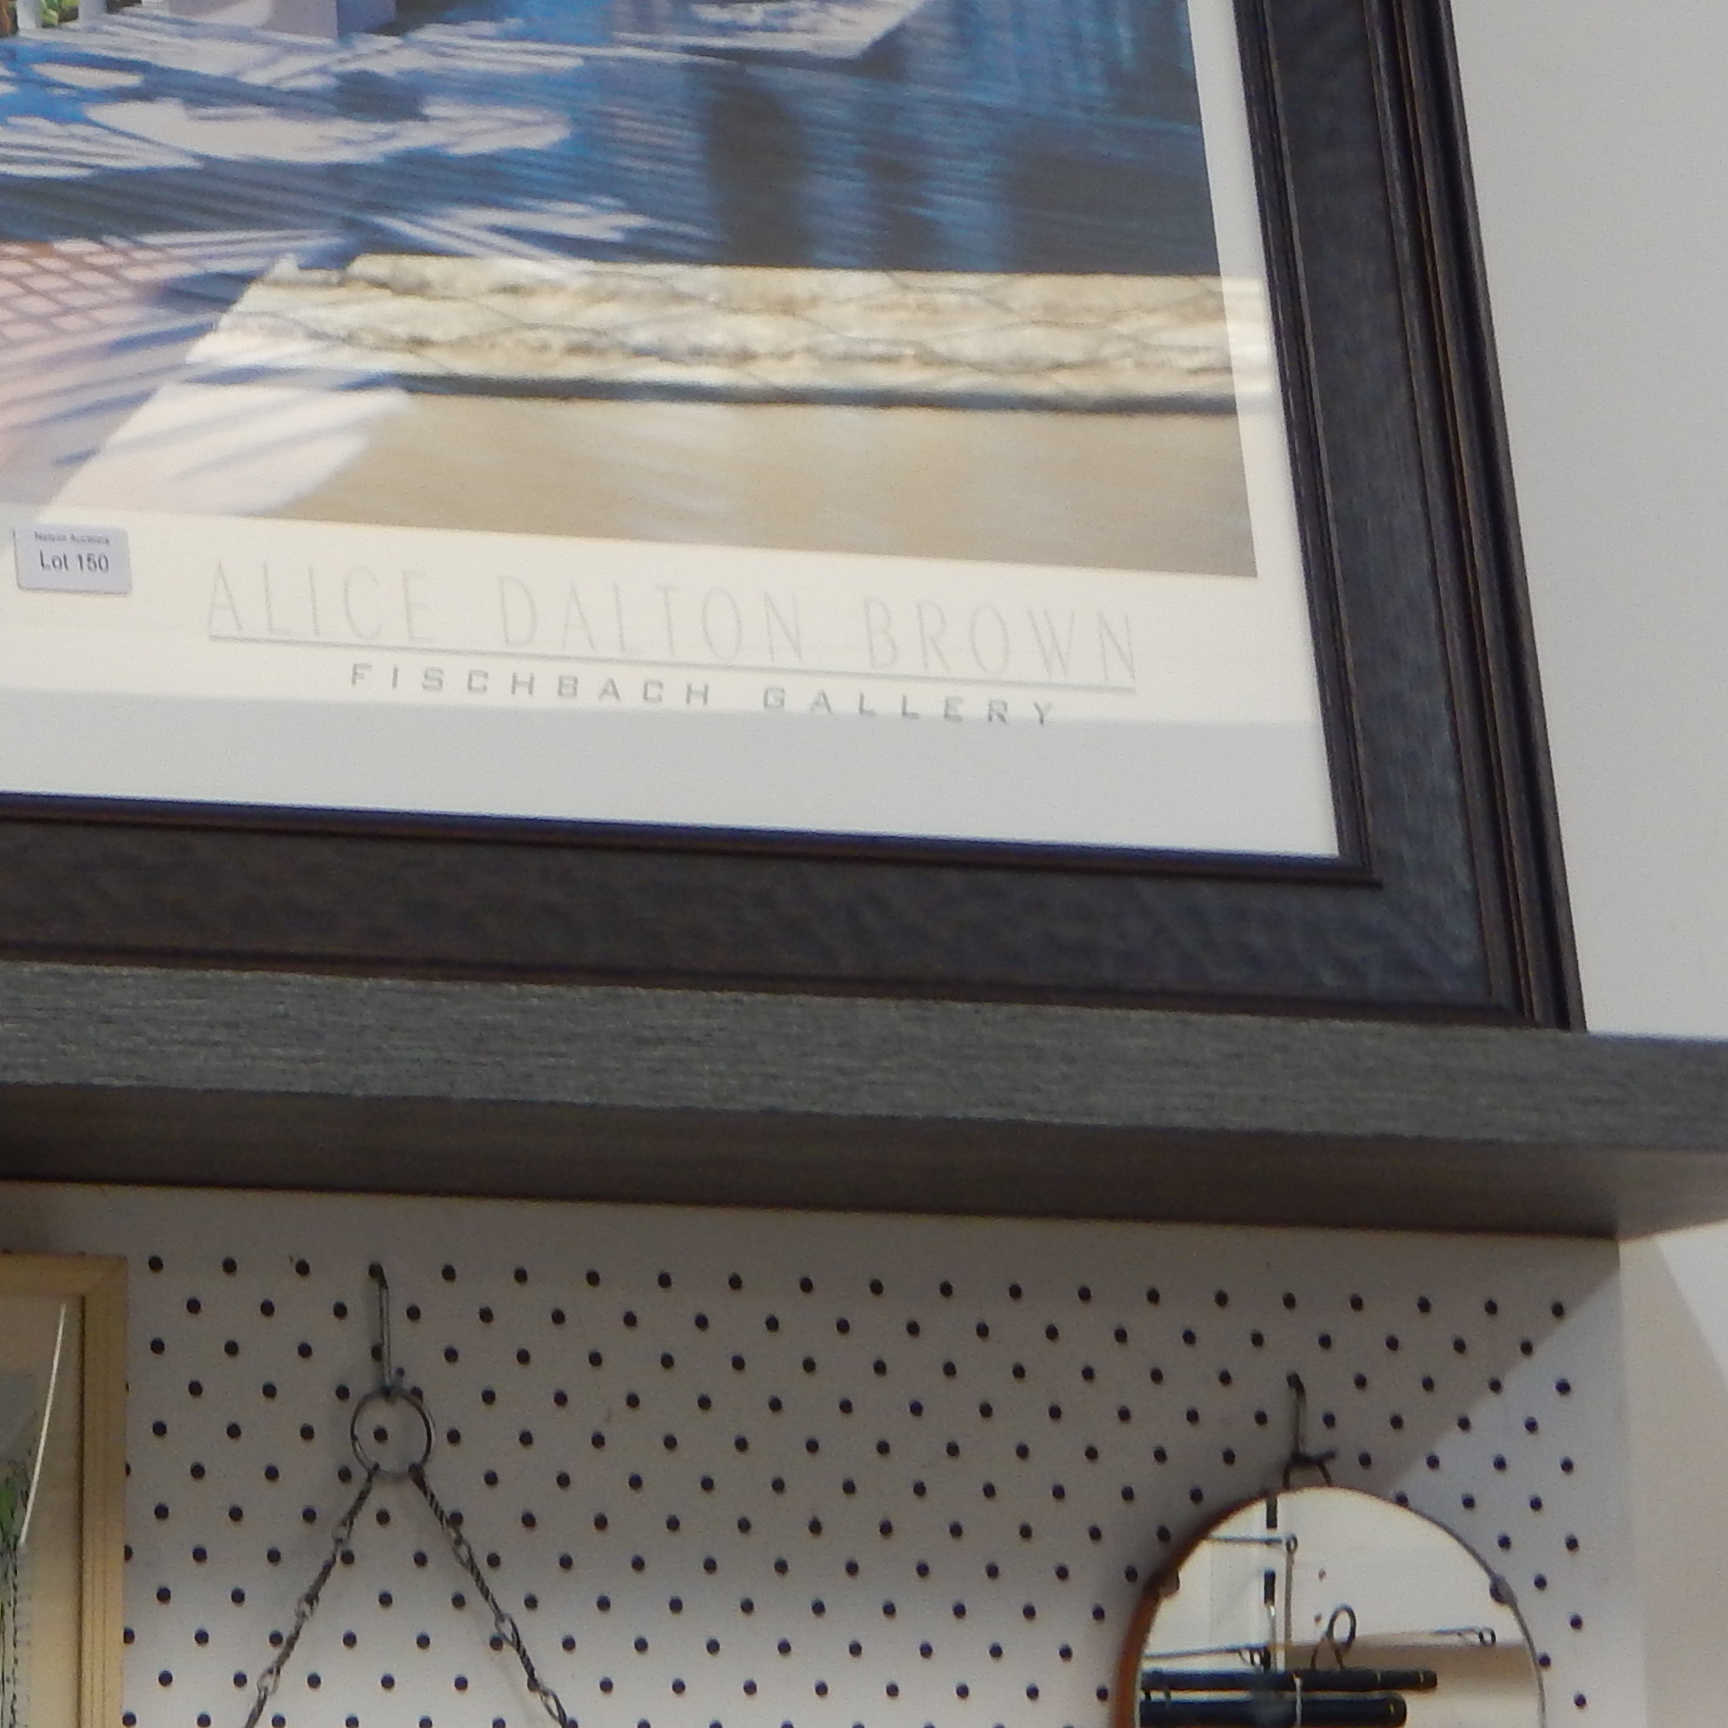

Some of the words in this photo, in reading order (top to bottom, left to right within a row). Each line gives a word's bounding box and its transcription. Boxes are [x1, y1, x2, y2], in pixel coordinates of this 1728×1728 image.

[39, 549, 69, 572] Lot
[77, 552, 110, 573] 150
[207, 558, 434, 642] ALICE
[497, 573, 804, 664] DALTON
[863, 596, 1138, 683] BROWN
[350, 661, 710, 707] FISCHBACH
[763, 686, 1055, 726] GALLERY
